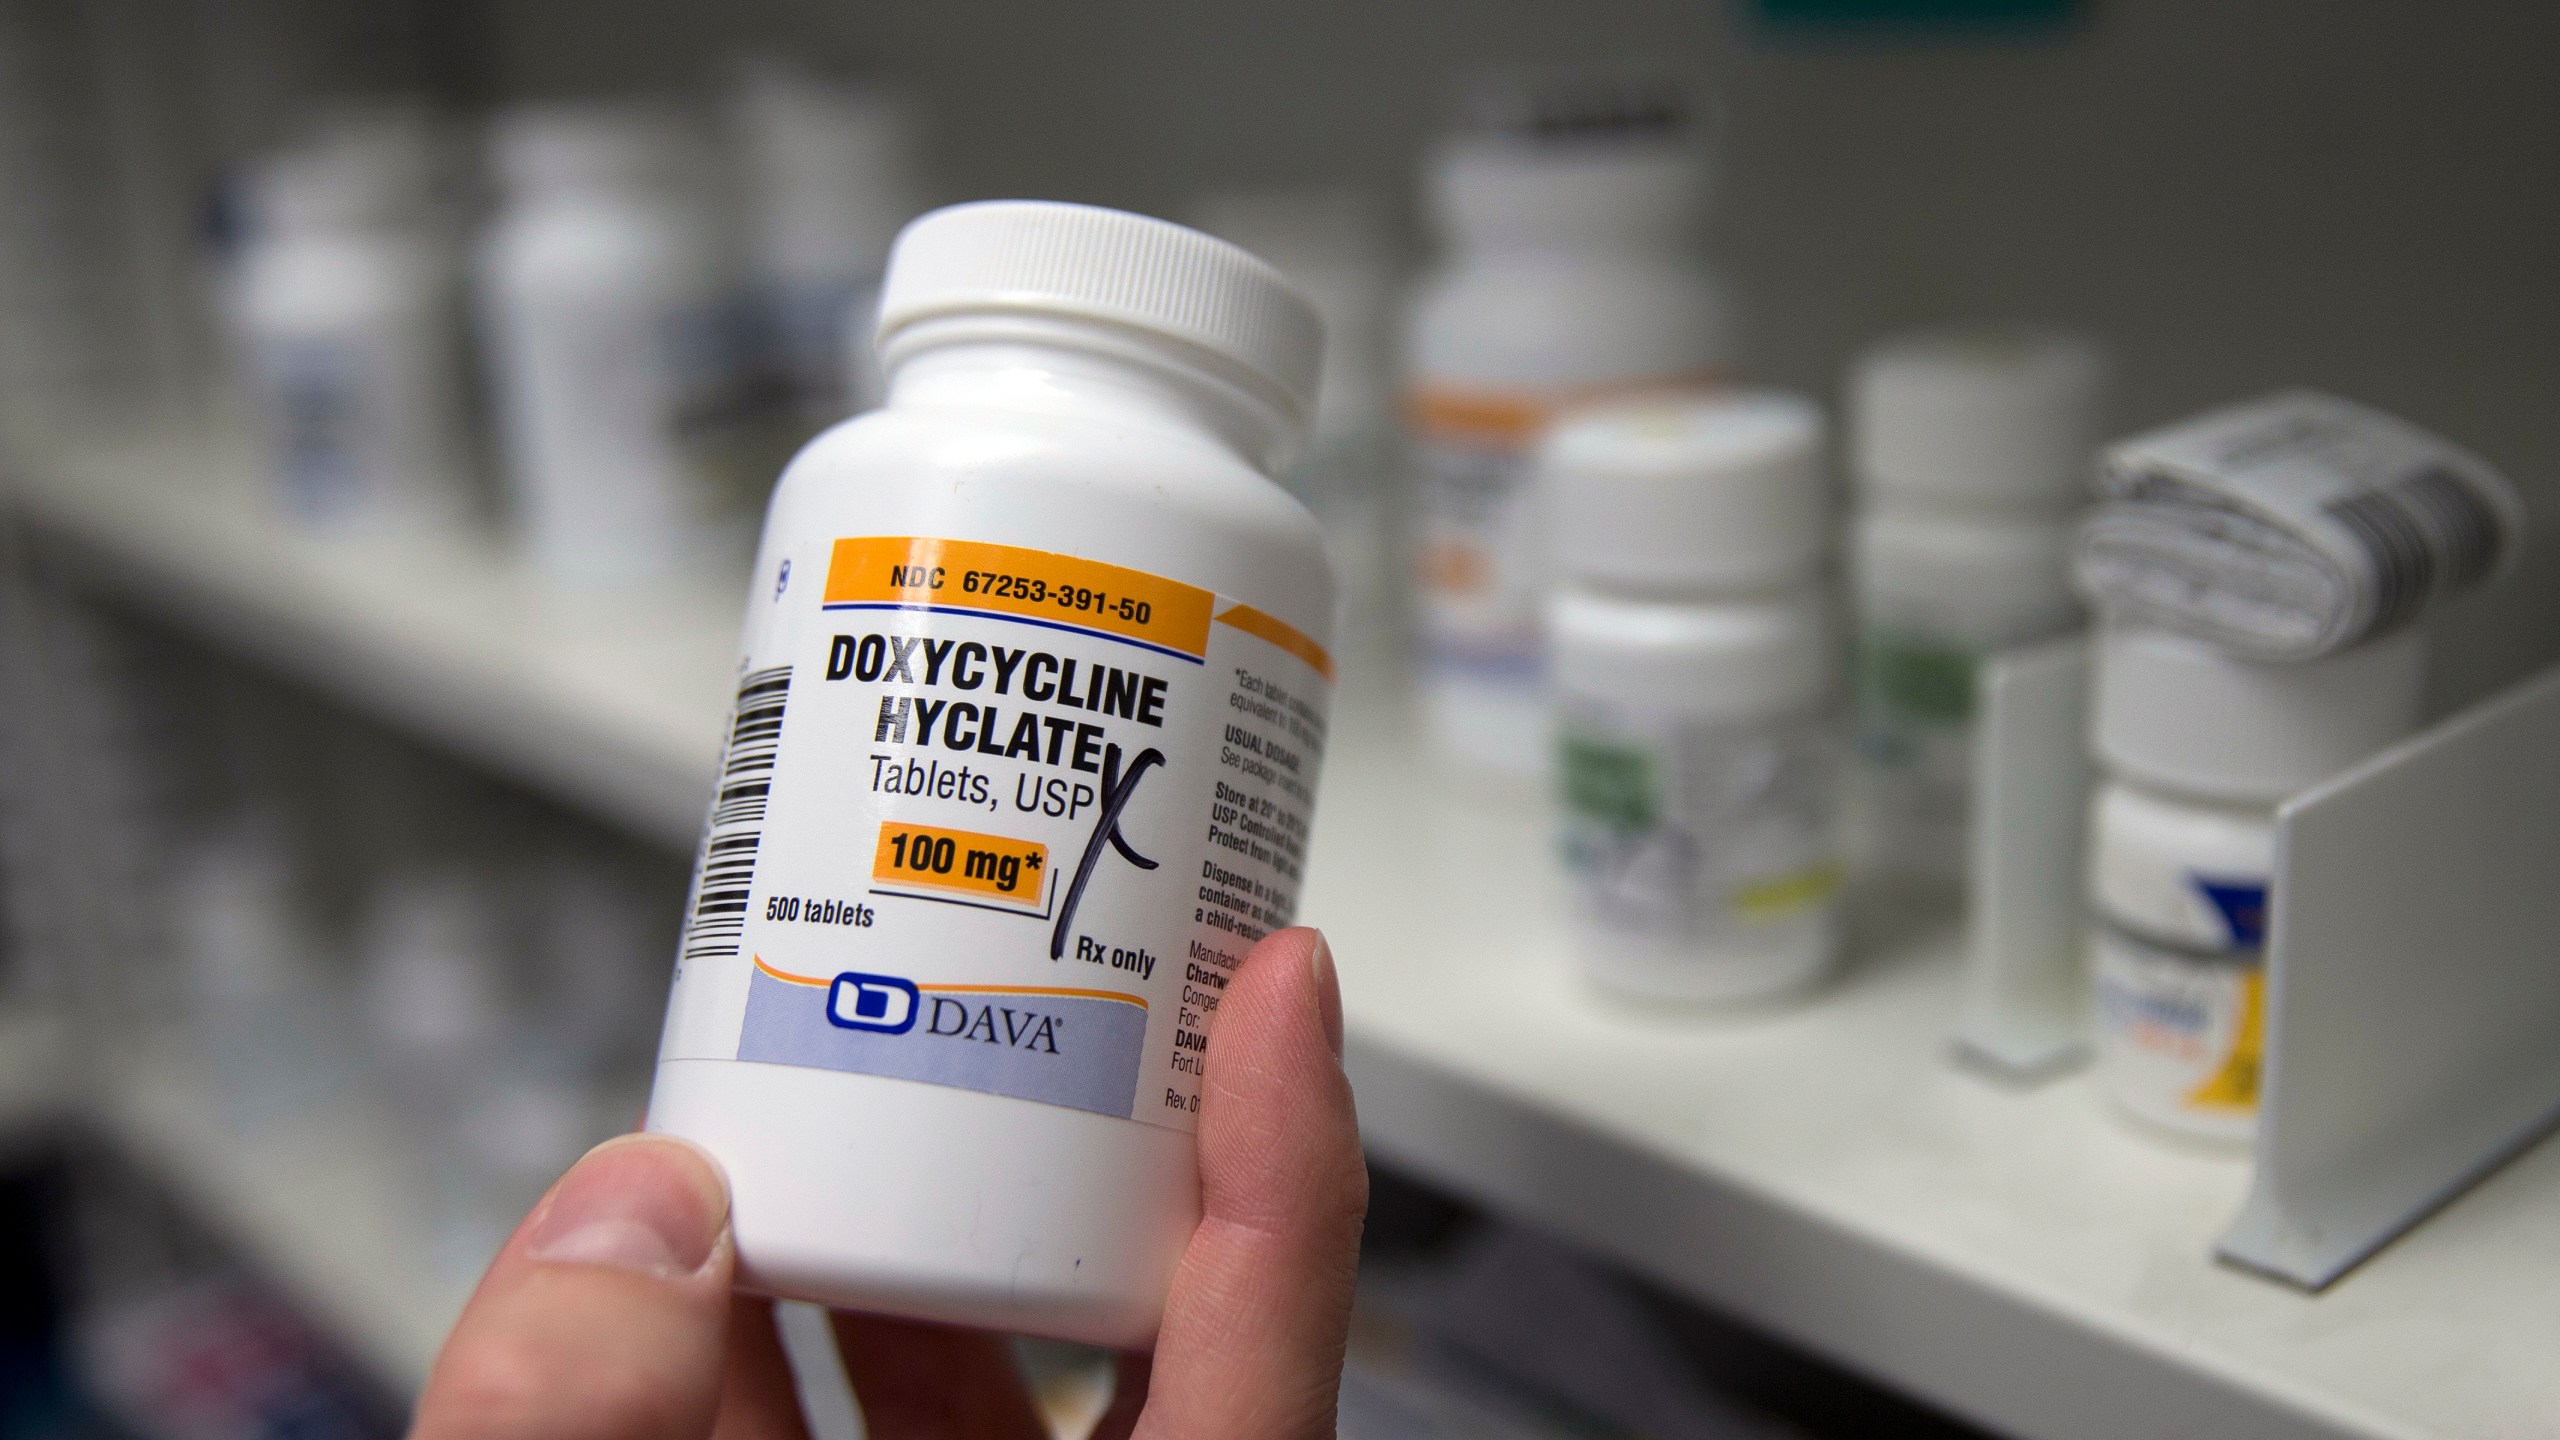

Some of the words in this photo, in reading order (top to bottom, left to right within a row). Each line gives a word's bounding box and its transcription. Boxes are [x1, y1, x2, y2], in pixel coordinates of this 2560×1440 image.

[890, 564, 946, 591] NDC
[962, 573, 1152, 625] 67253-391-50
[825, 633, 1169, 728] DOXYCYCLINE
[873, 694, 1106, 774] HYCLATE
[1224, 724, 1263, 755] USUAL
[1221, 745, 1241, 769] See
[870, 753, 998, 813] Tablets,
[1015, 777, 1094, 822] USP
[1216, 781, 1246, 808] Store
[1212, 802, 1238, 826] USP
[889, 831, 955, 874] 100
[1208, 824, 1249, 855] Protect
[1202, 859, 1254, 895] Dispense
[765, 896, 800, 922] 500
[803, 897, 874, 928] tablets
[1194, 907, 1204, 923] a
[1198, 885, 1250, 916] container
[1077, 935, 1109, 967] Rx
[1111, 946, 1157, 980] only
[1189, 939, 1242, 972] Manufactu
[1186, 962, 1230, 990] Chartw
[1178, 1006, 1200, 1029] For:
[1175, 1028, 1208, 1054] DAVA
[1171, 1050, 1194, 1074] Fort
[1165, 1087, 1187, 1111] Rev.
